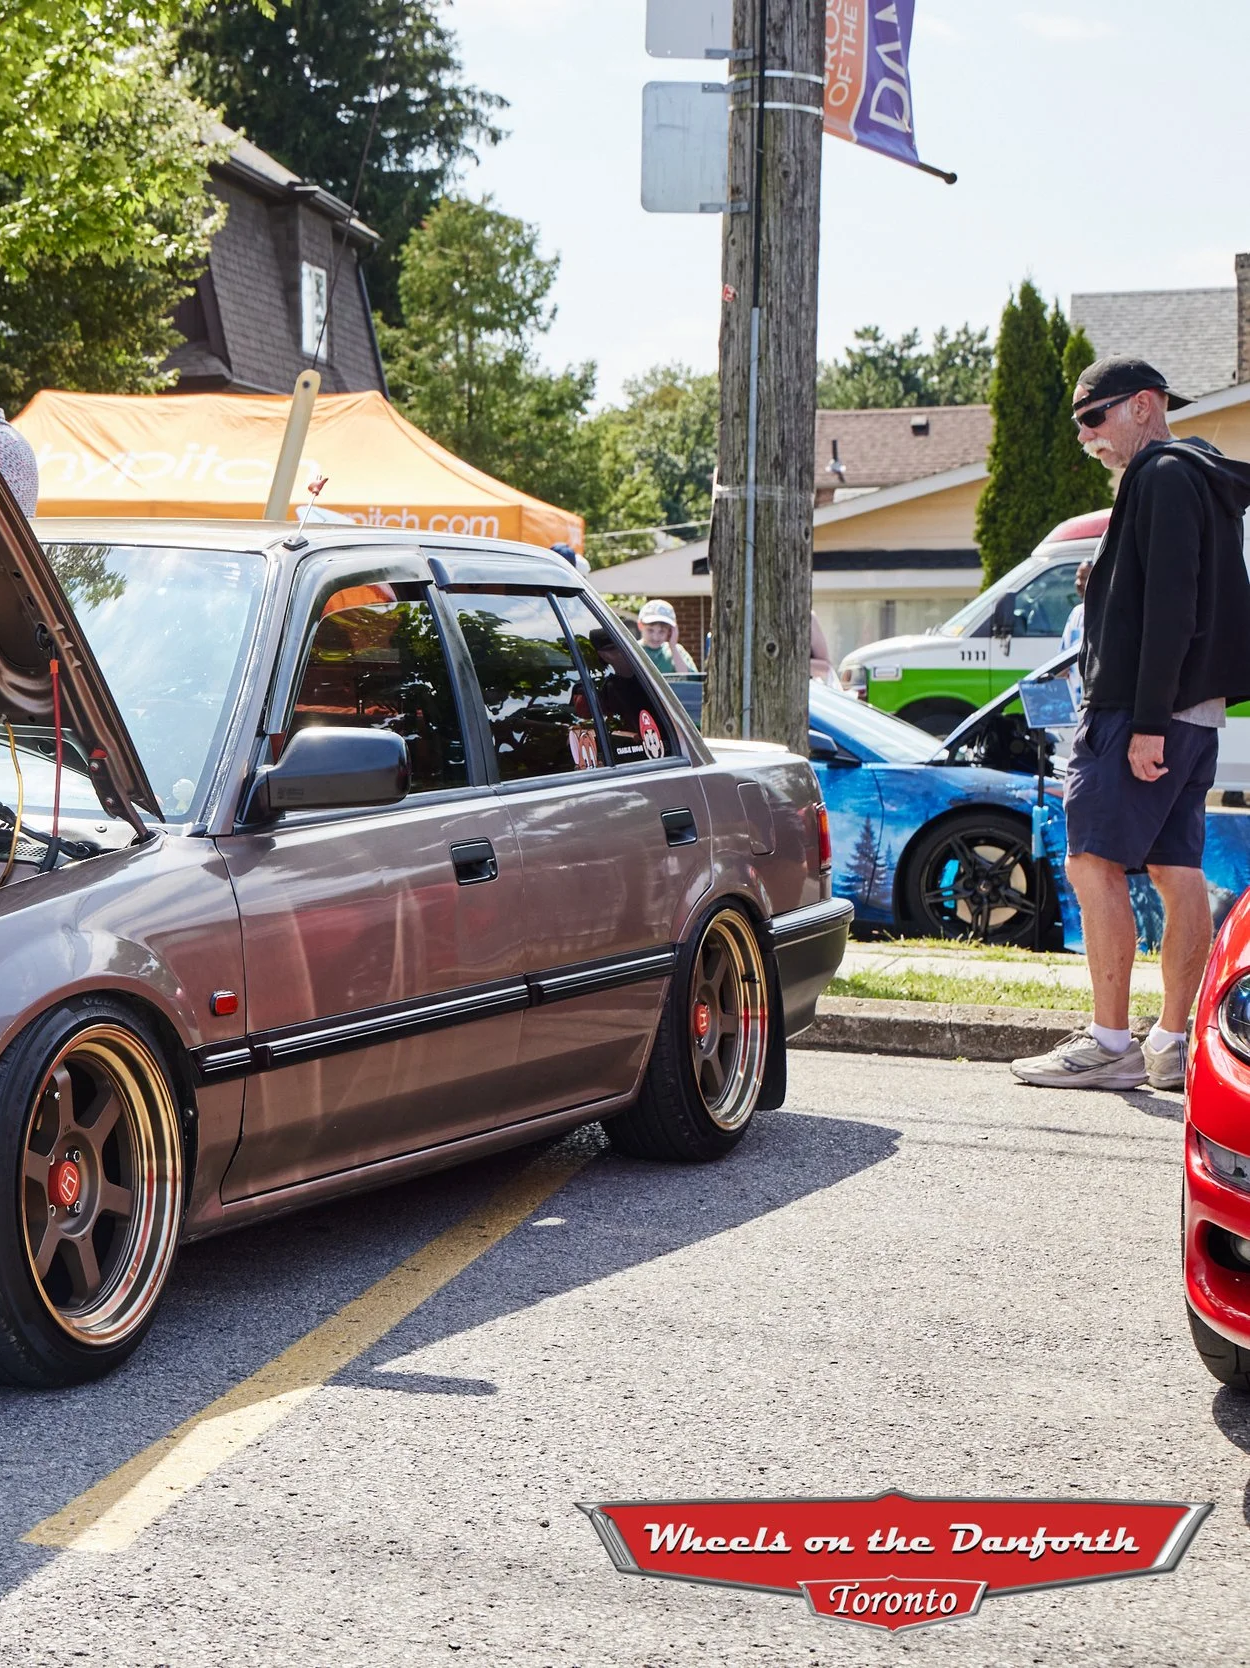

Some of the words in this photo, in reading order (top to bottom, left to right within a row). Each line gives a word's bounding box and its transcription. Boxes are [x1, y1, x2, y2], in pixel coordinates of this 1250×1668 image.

[840, 3, 858, 58] THE
[828, 63, 853, 106] OF
[960, 650, 986, 661] 1111
